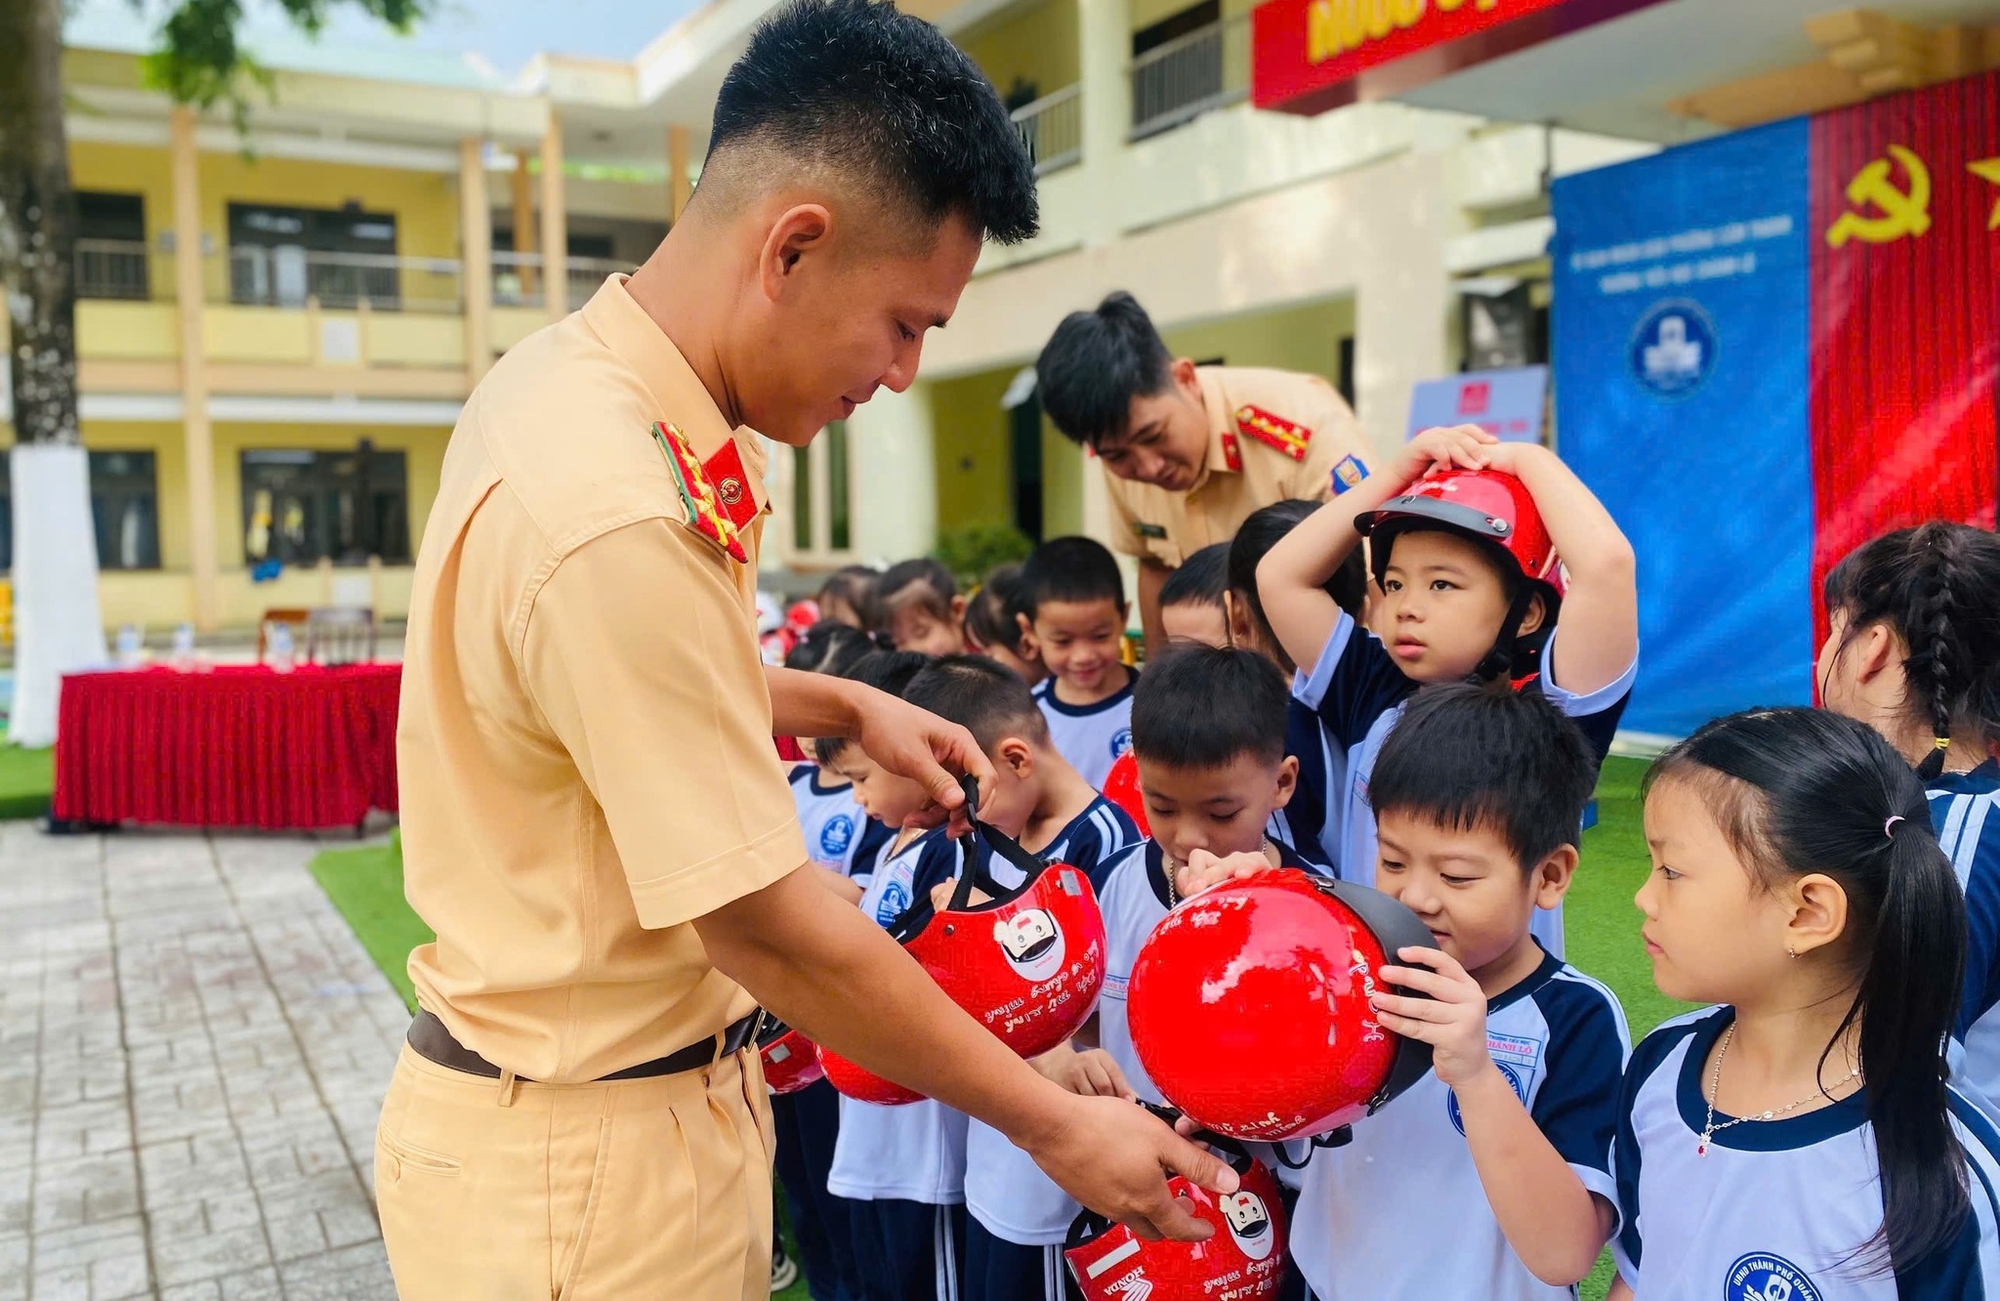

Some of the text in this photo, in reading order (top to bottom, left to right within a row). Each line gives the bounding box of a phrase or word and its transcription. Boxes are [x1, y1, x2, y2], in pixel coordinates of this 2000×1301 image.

[1103, 1265, 1145, 1296] HONDA
[1733, 1265, 1750, 1287] UBND
[1748, 1259, 1774, 1271] THÀNH
[1775, 1264, 1796, 1280] PHỐ
